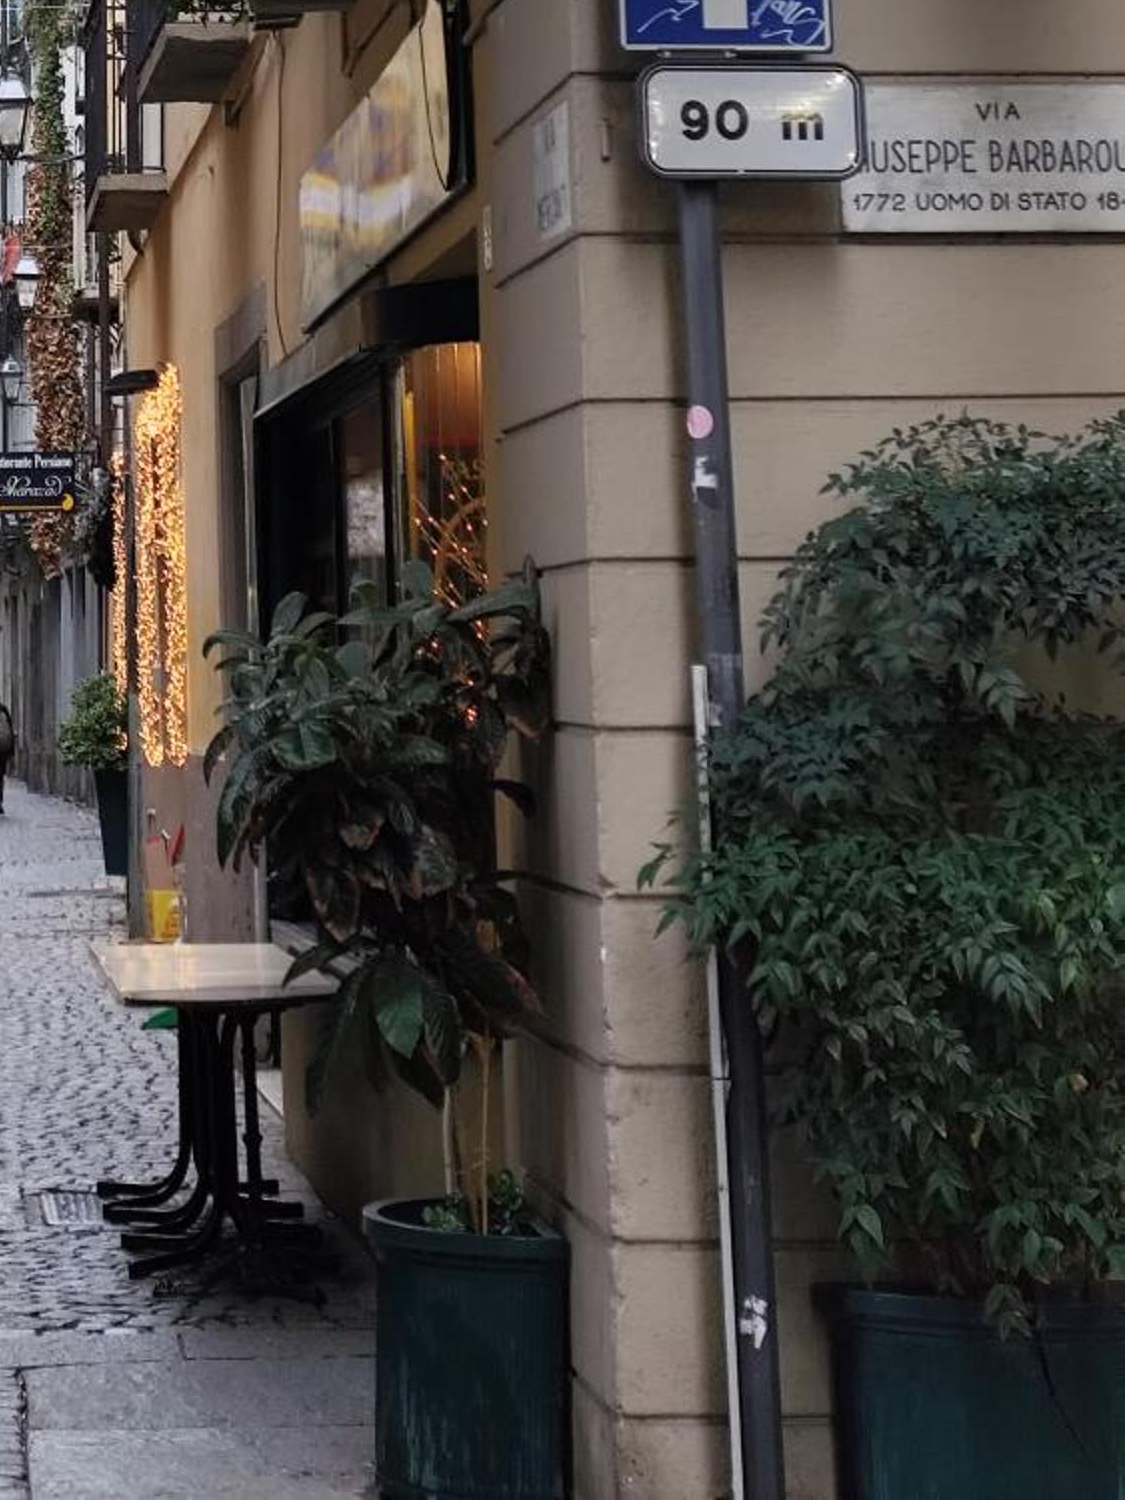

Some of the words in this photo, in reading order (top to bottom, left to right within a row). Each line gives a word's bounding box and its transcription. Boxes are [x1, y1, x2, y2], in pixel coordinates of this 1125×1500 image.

[680, 100, 749, 141] 90
[781, 112, 824, 141] m
[975, 102, 1021, 121] VIA
[865, 139, 978, 174] IUSEPPE
[854, 192, 907, 212] 1772
[915, 192, 984, 212] UOMO
[990, 192, 1011, 212] DI
[1017, 192, 1088, 212] STATO
[1096, 191, 1125, 211] 18
